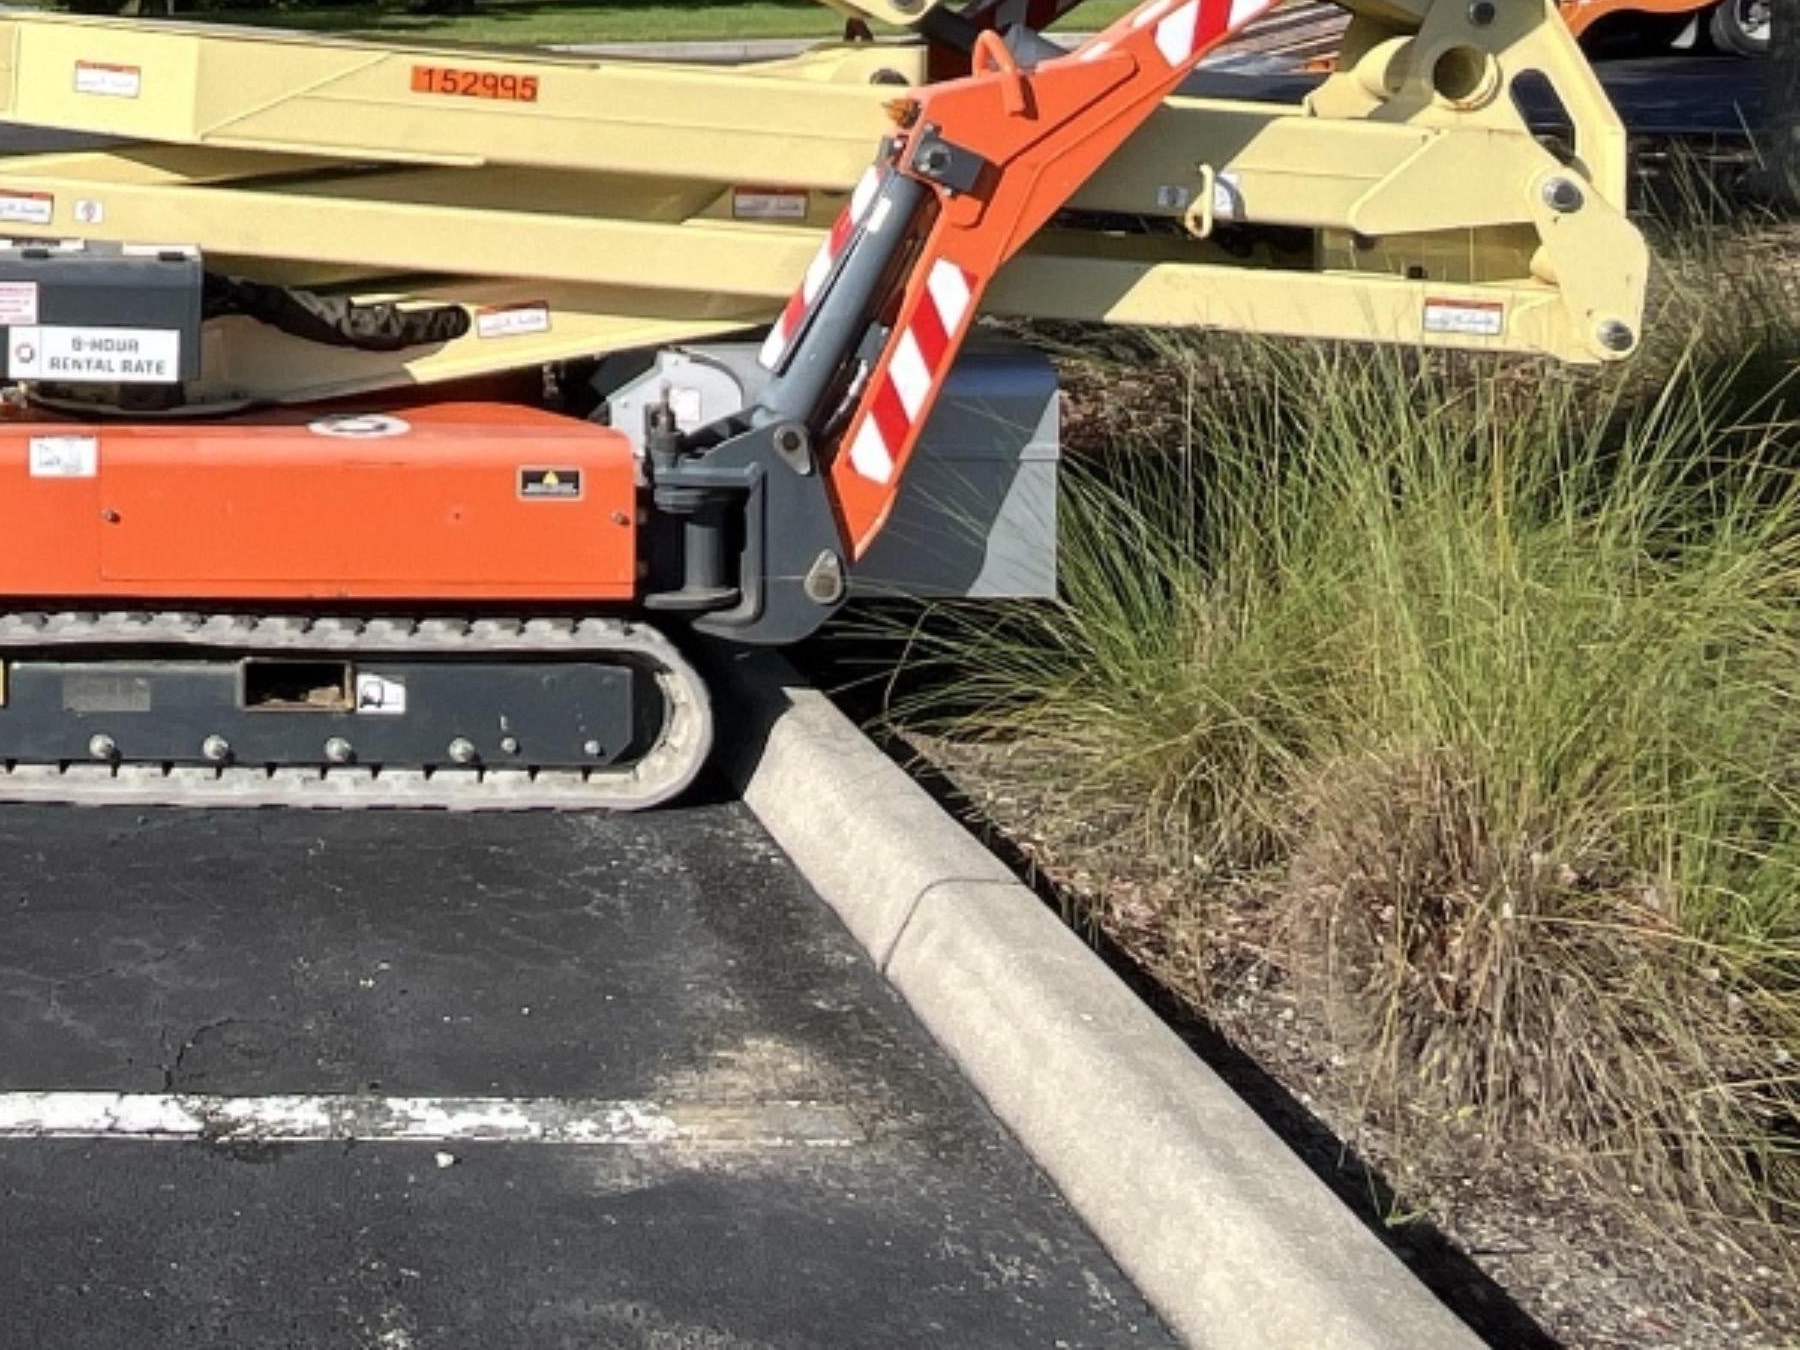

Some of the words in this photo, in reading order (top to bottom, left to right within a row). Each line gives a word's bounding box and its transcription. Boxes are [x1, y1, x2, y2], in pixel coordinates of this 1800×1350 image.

[422, 68, 538, 102] 152995
[48, 356, 116, 374] RENTAL
[120, 359, 167, 377] RATE
